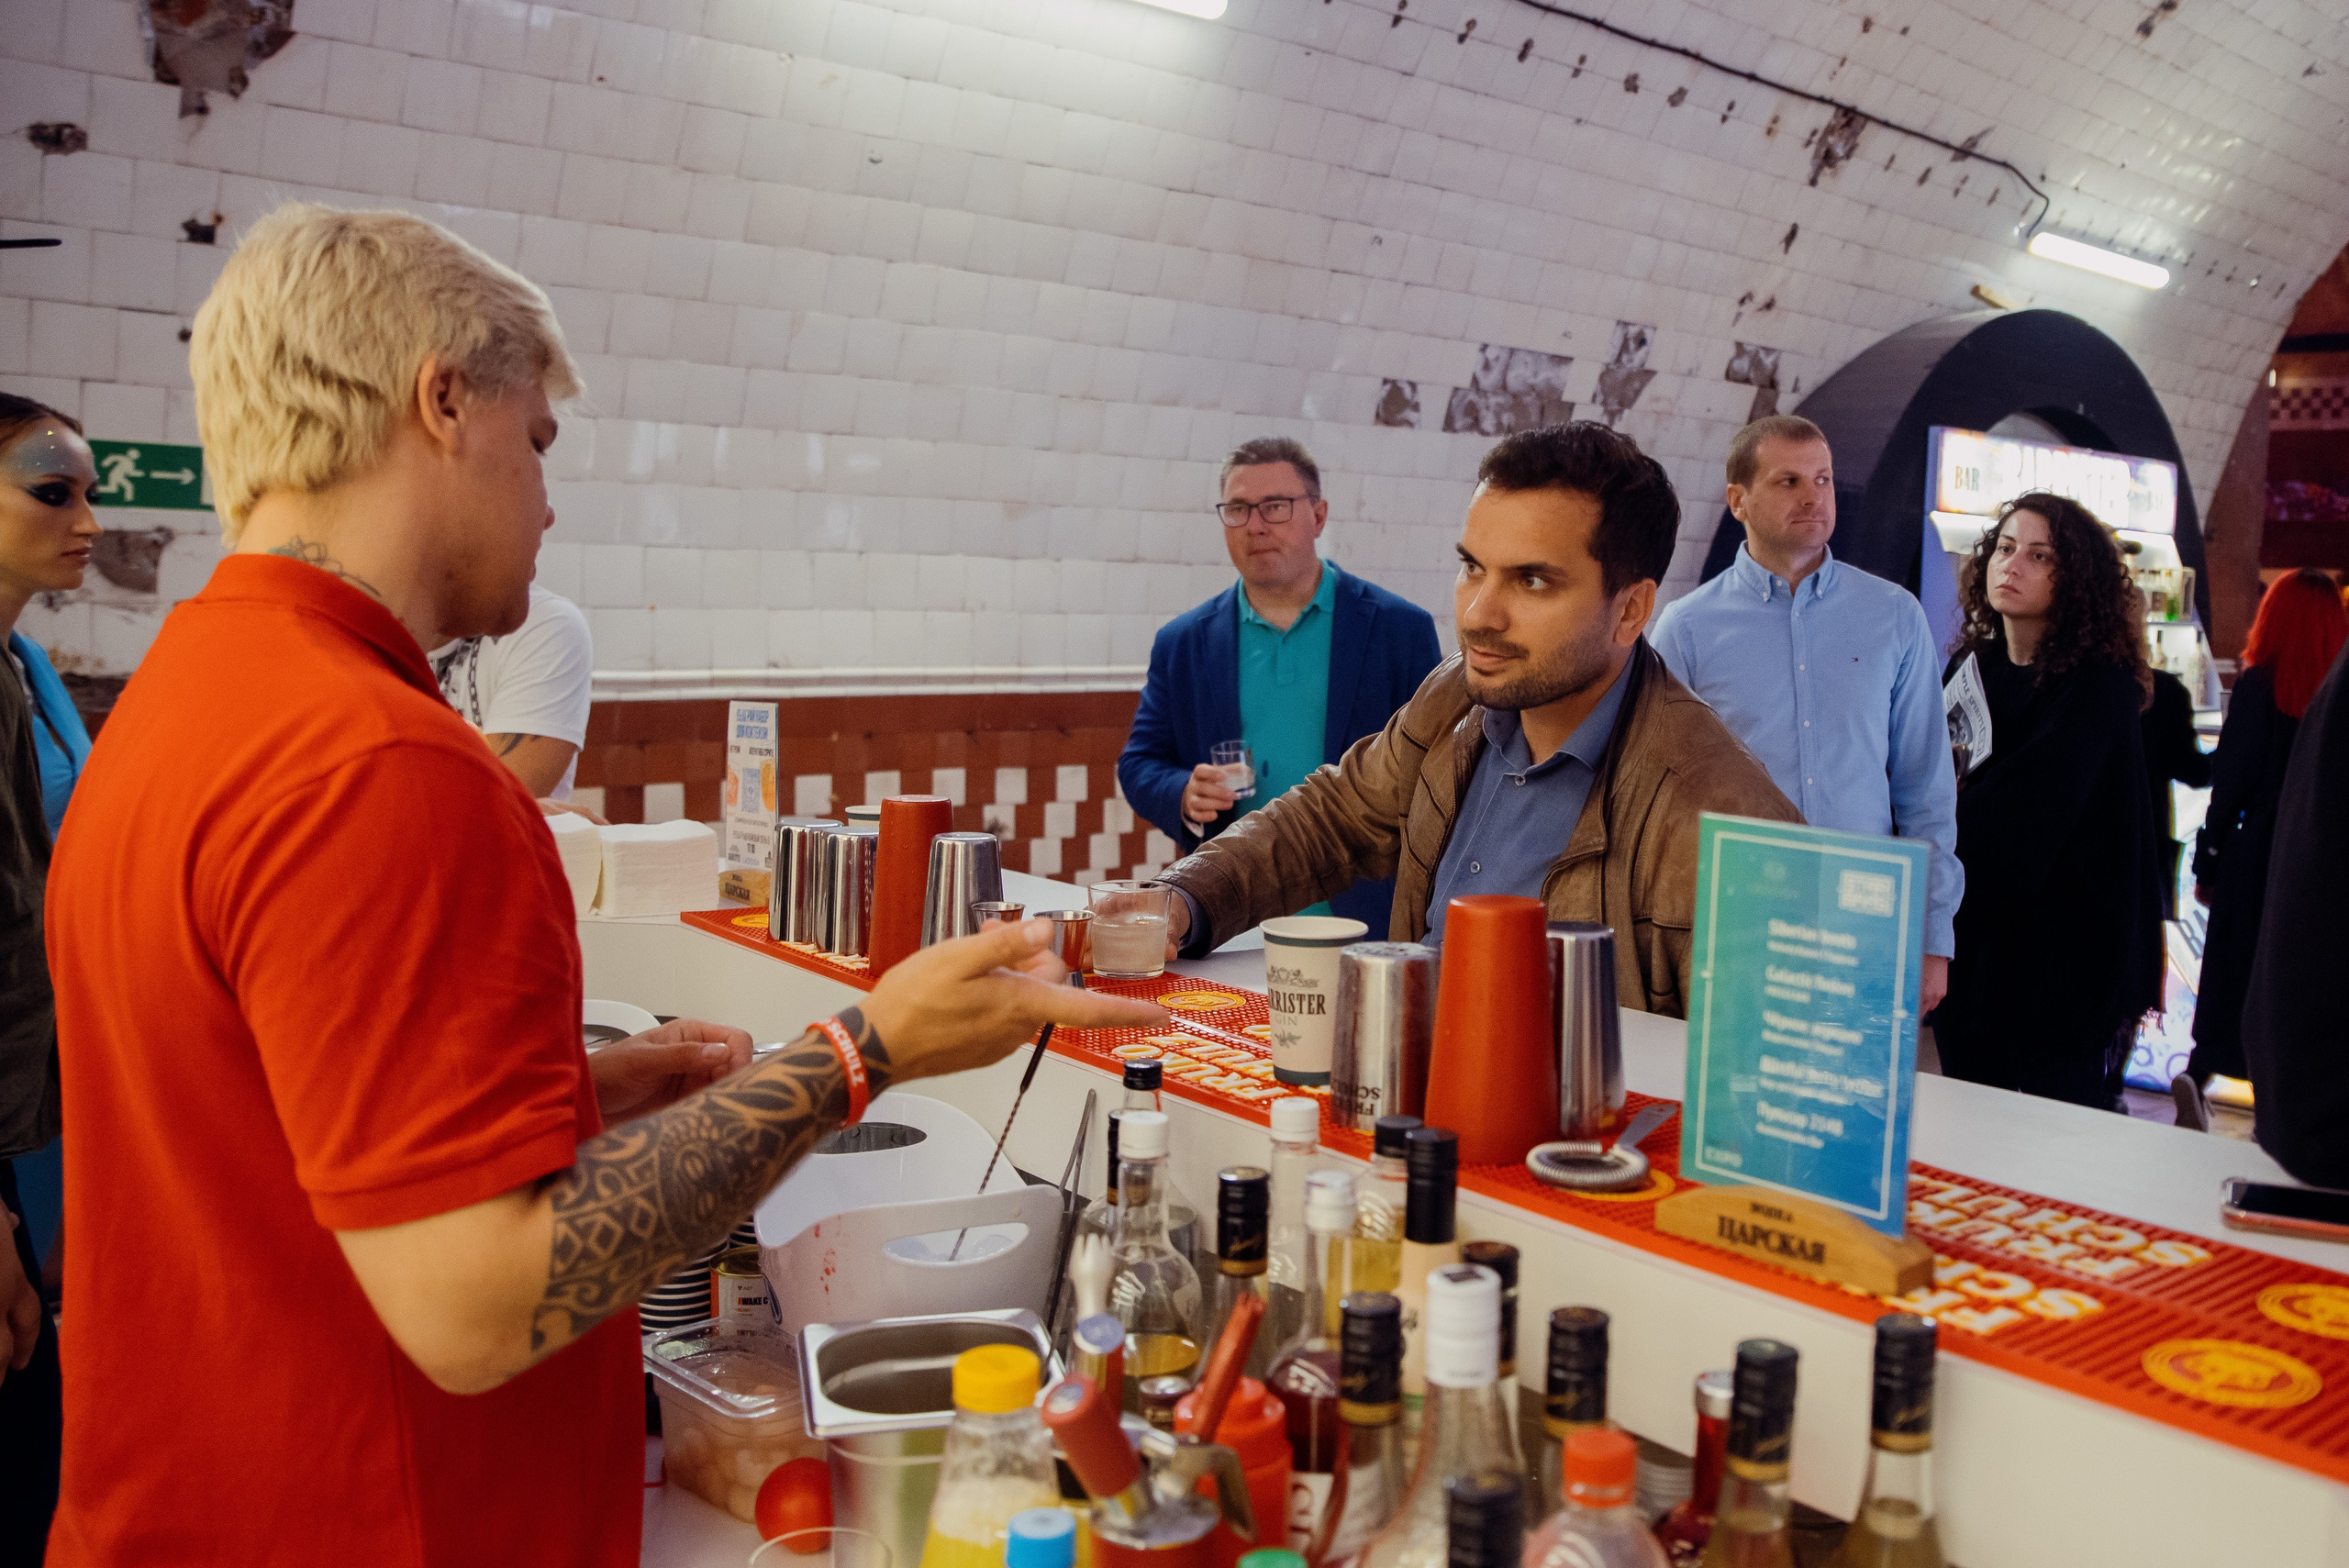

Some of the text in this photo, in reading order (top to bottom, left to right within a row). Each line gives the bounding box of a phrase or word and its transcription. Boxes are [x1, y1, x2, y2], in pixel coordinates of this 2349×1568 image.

[1954, 465, 1980, 492] BAR
[1268, 988, 1327, 1015] RRISTER
[1275, 1014, 1297, 1027] GIN
[1720, 1215, 1824, 1264] ЦАРСКАЯ
[738, 1296, 763, 1306] AWAKE
